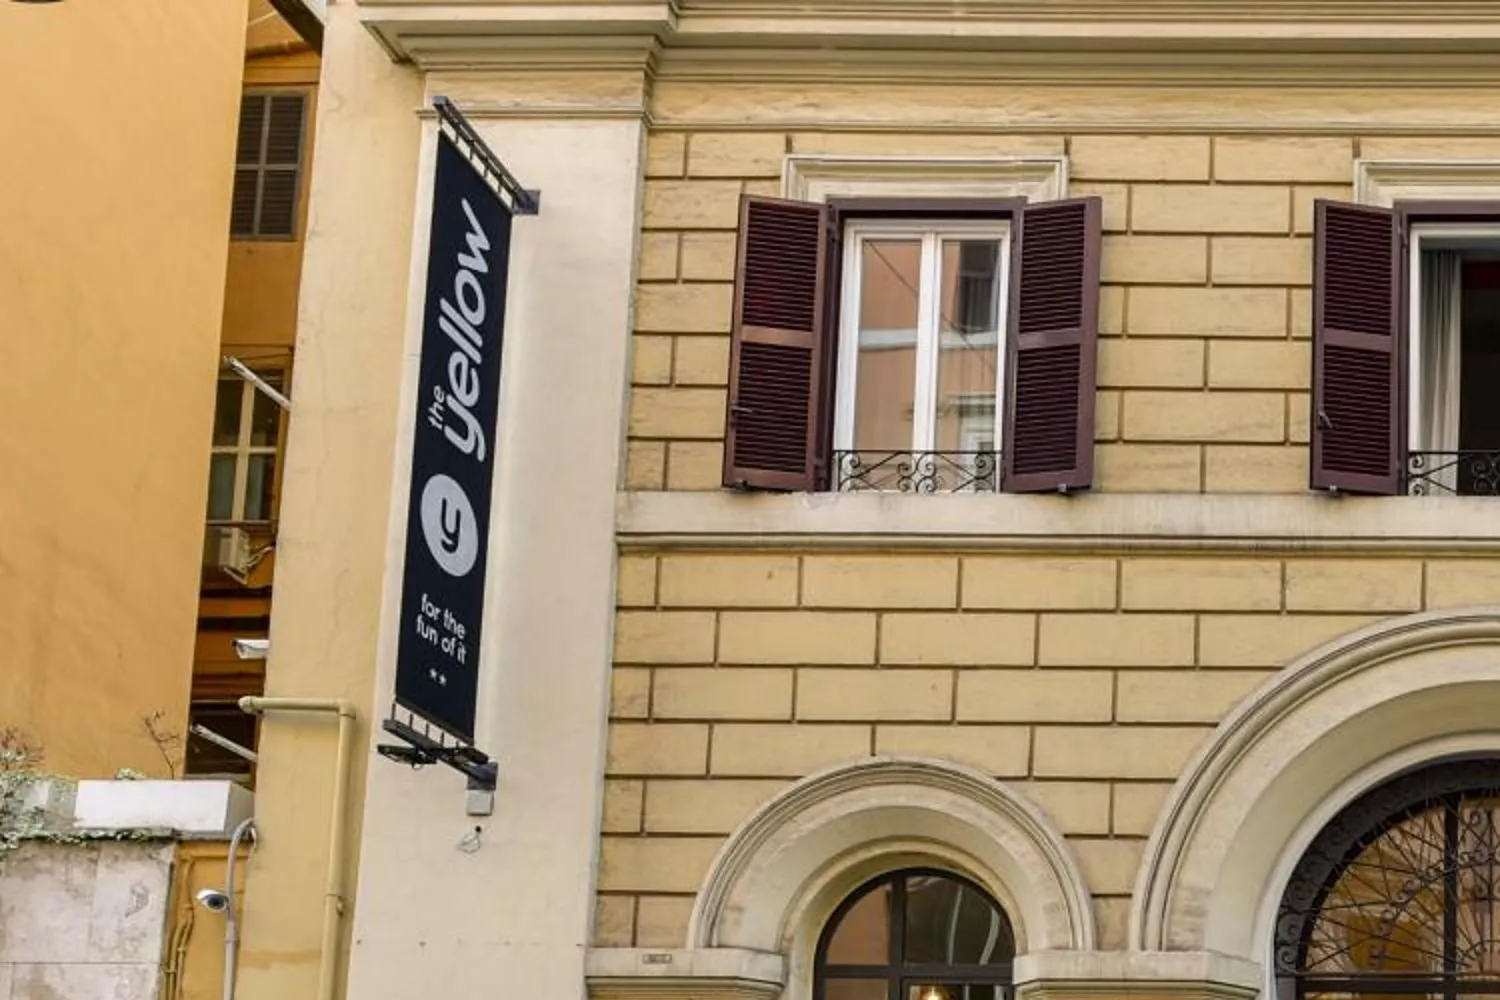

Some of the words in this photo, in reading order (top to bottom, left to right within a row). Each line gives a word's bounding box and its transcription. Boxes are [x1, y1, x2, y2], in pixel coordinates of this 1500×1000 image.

[428, 385, 445, 431] the
[439, 197, 491, 462] yellow
[416, 614, 439, 646] fun
[441, 637, 456, 657] of
[457, 641, 467, 665] it
[421, 593, 441, 621] for
[443, 608, 466, 640] the
